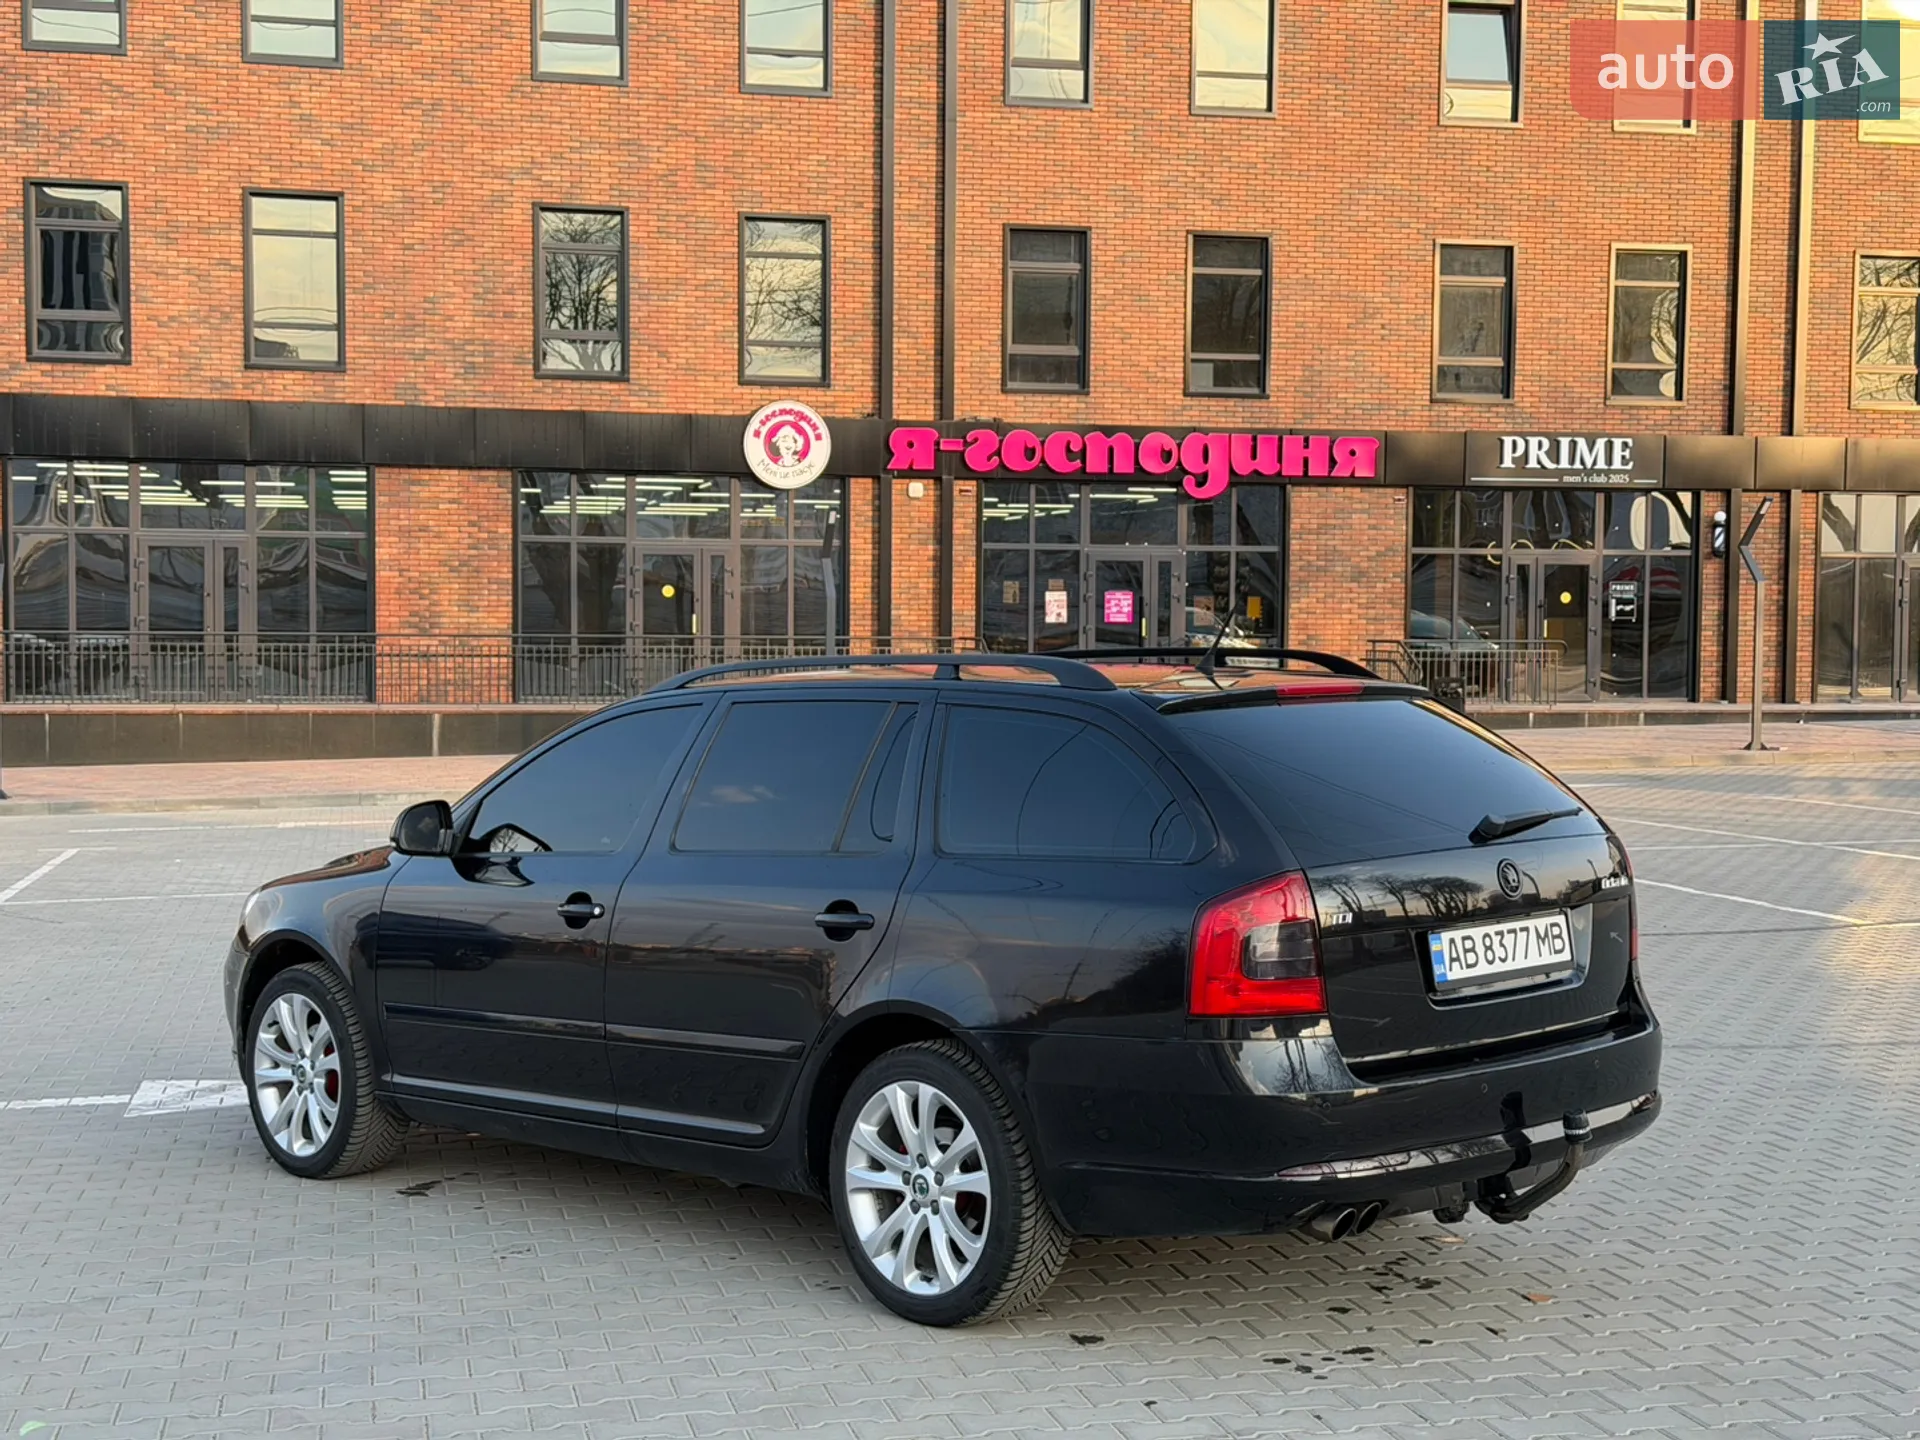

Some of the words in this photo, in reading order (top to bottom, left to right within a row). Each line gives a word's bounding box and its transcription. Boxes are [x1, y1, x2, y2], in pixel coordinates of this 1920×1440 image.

[1499, 435, 1634, 470] PRIME
[1562, 473, 1588, 483] men's
[1588, 473, 1608, 483] club
[1608, 473, 1630, 484] 2025
[1448, 934, 1479, 972] AB
[1482, 925, 1531, 966] 8377
[1534, 921, 1566, 958] MB
